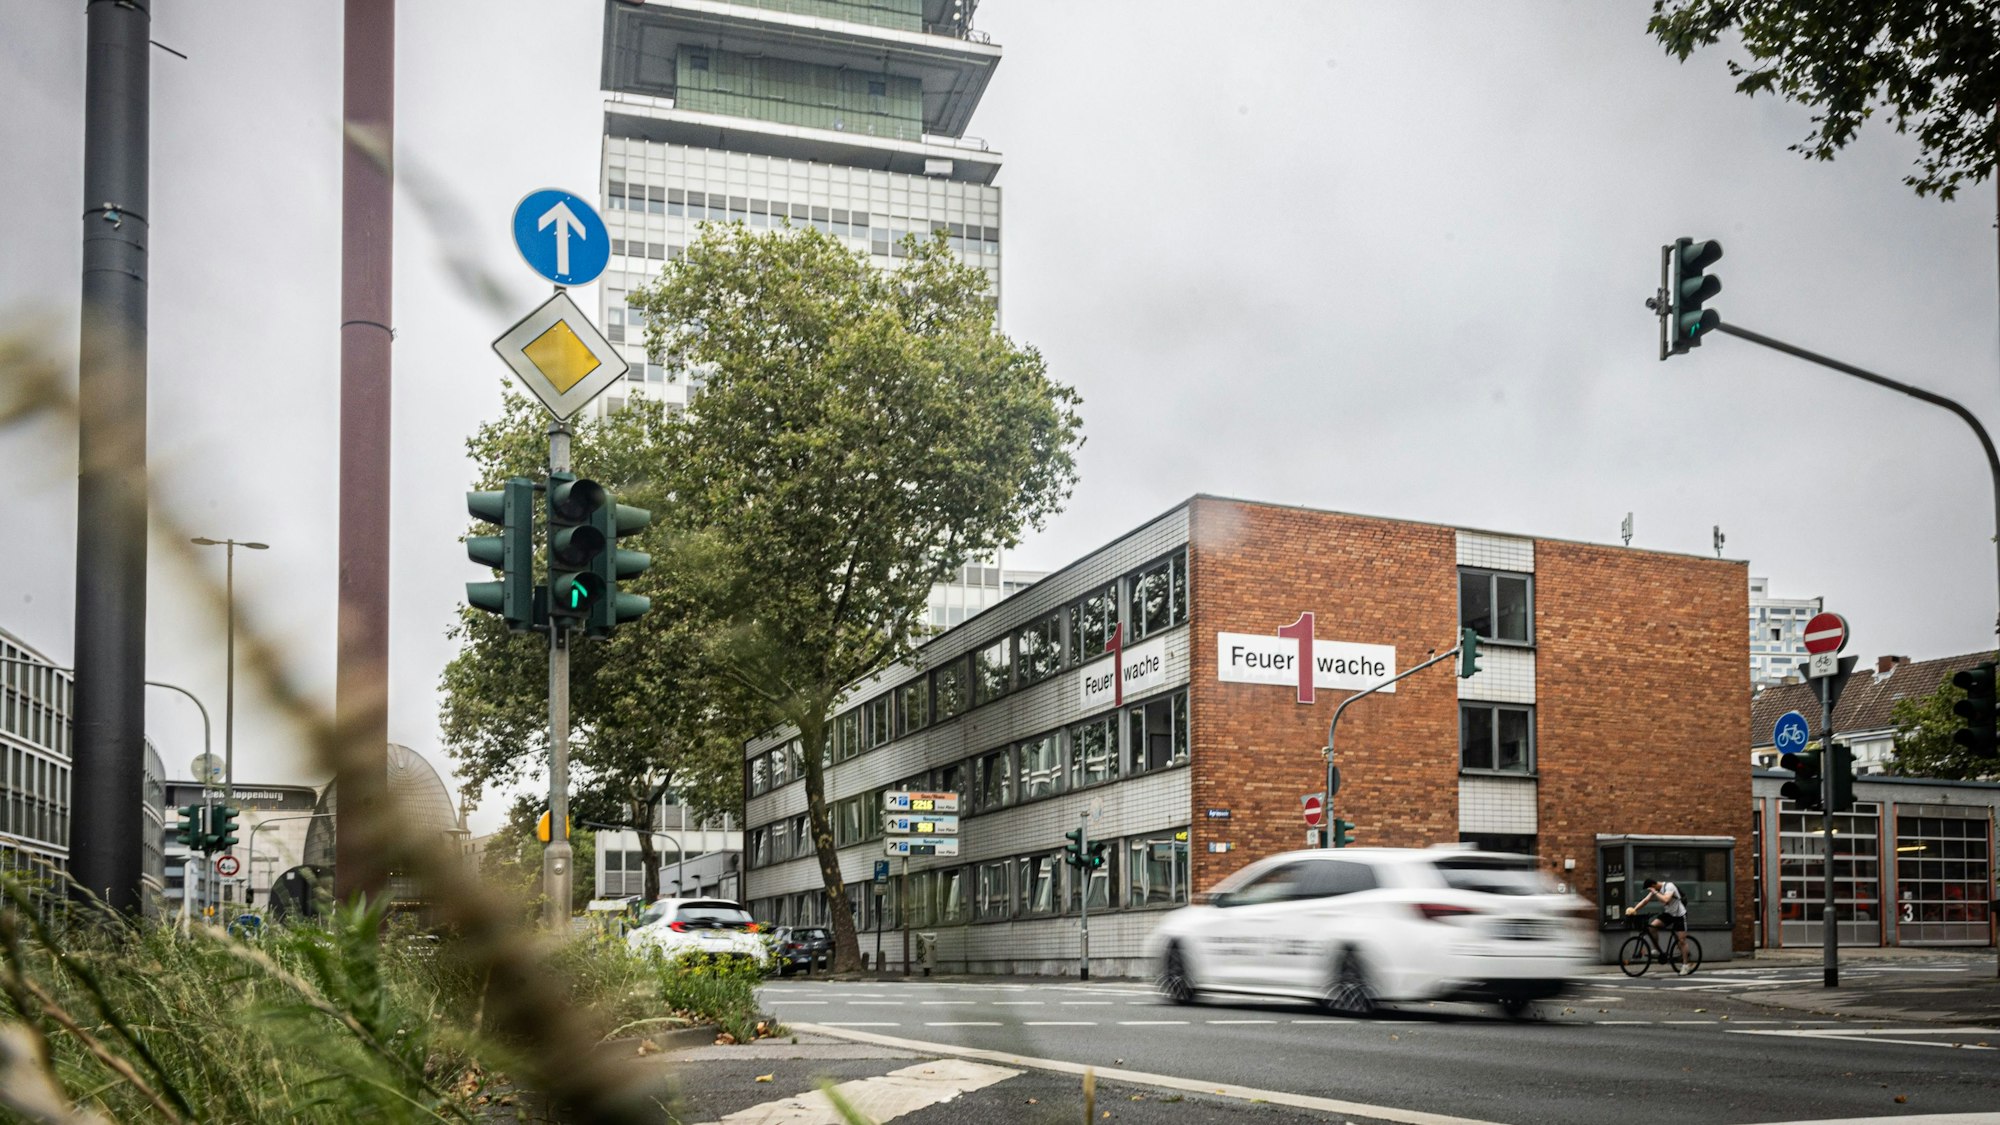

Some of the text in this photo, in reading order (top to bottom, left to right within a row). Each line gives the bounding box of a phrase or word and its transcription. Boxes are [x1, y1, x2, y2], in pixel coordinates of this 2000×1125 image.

[1085, 620, 1159, 708] Feuer 1 wache
[1231, 611, 1385, 704] Feuer 1 wache
[1903, 903, 1914, 922] 3
